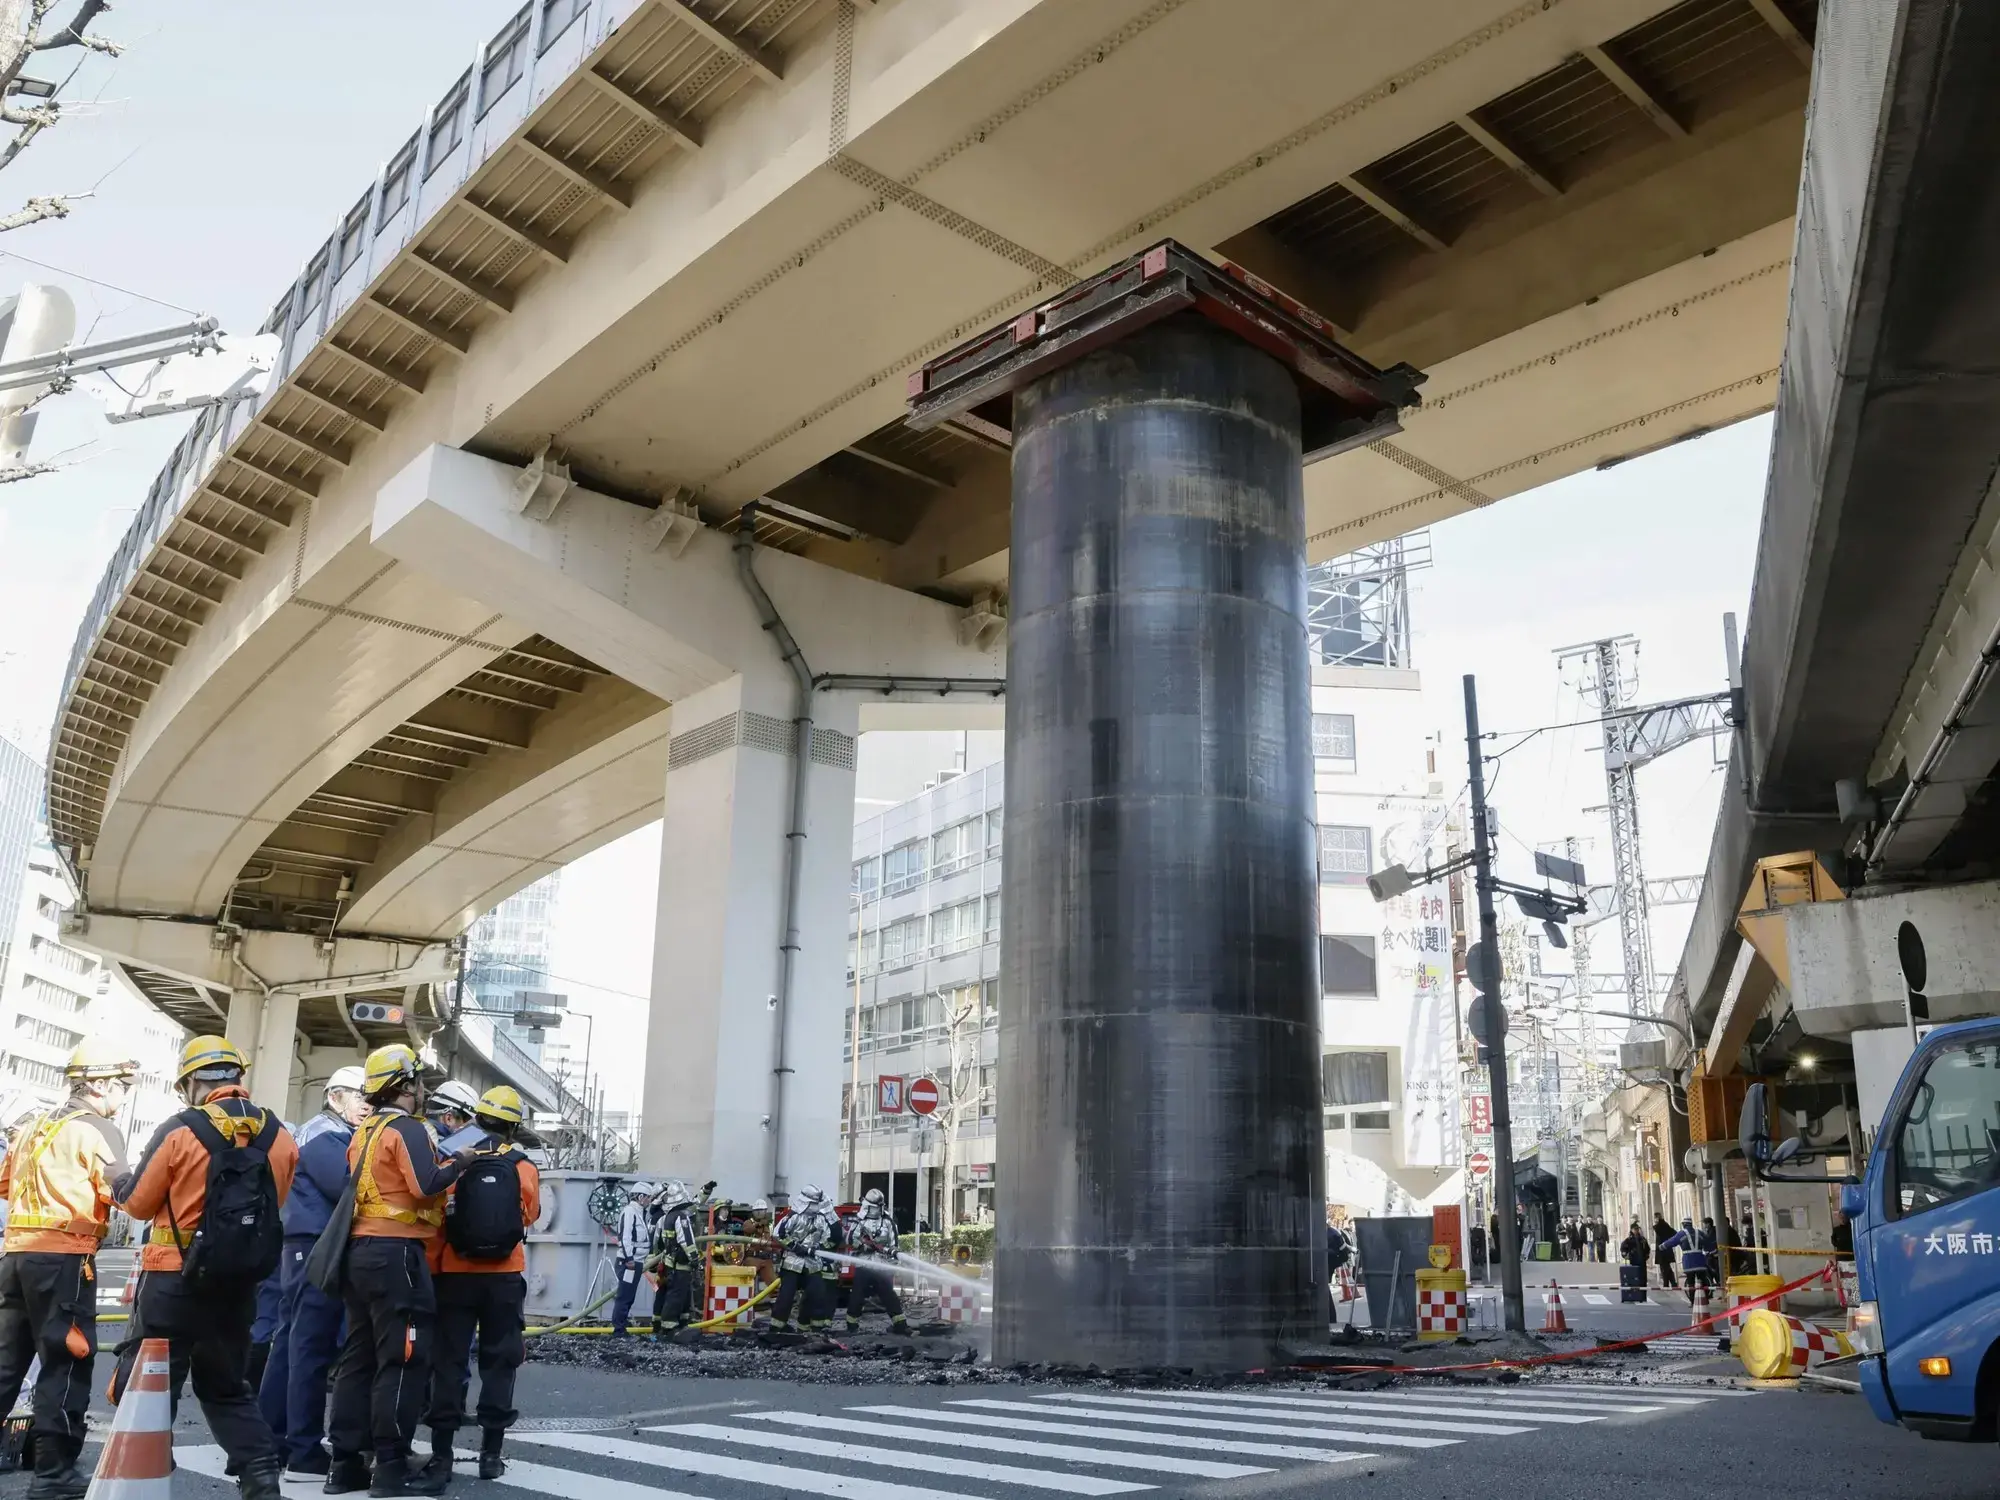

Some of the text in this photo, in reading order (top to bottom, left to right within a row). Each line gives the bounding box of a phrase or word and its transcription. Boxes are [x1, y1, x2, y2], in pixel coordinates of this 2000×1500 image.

[1406, 1081, 1429, 1090] KING
[1924, 1232, 2000, 1256] 大阪市
